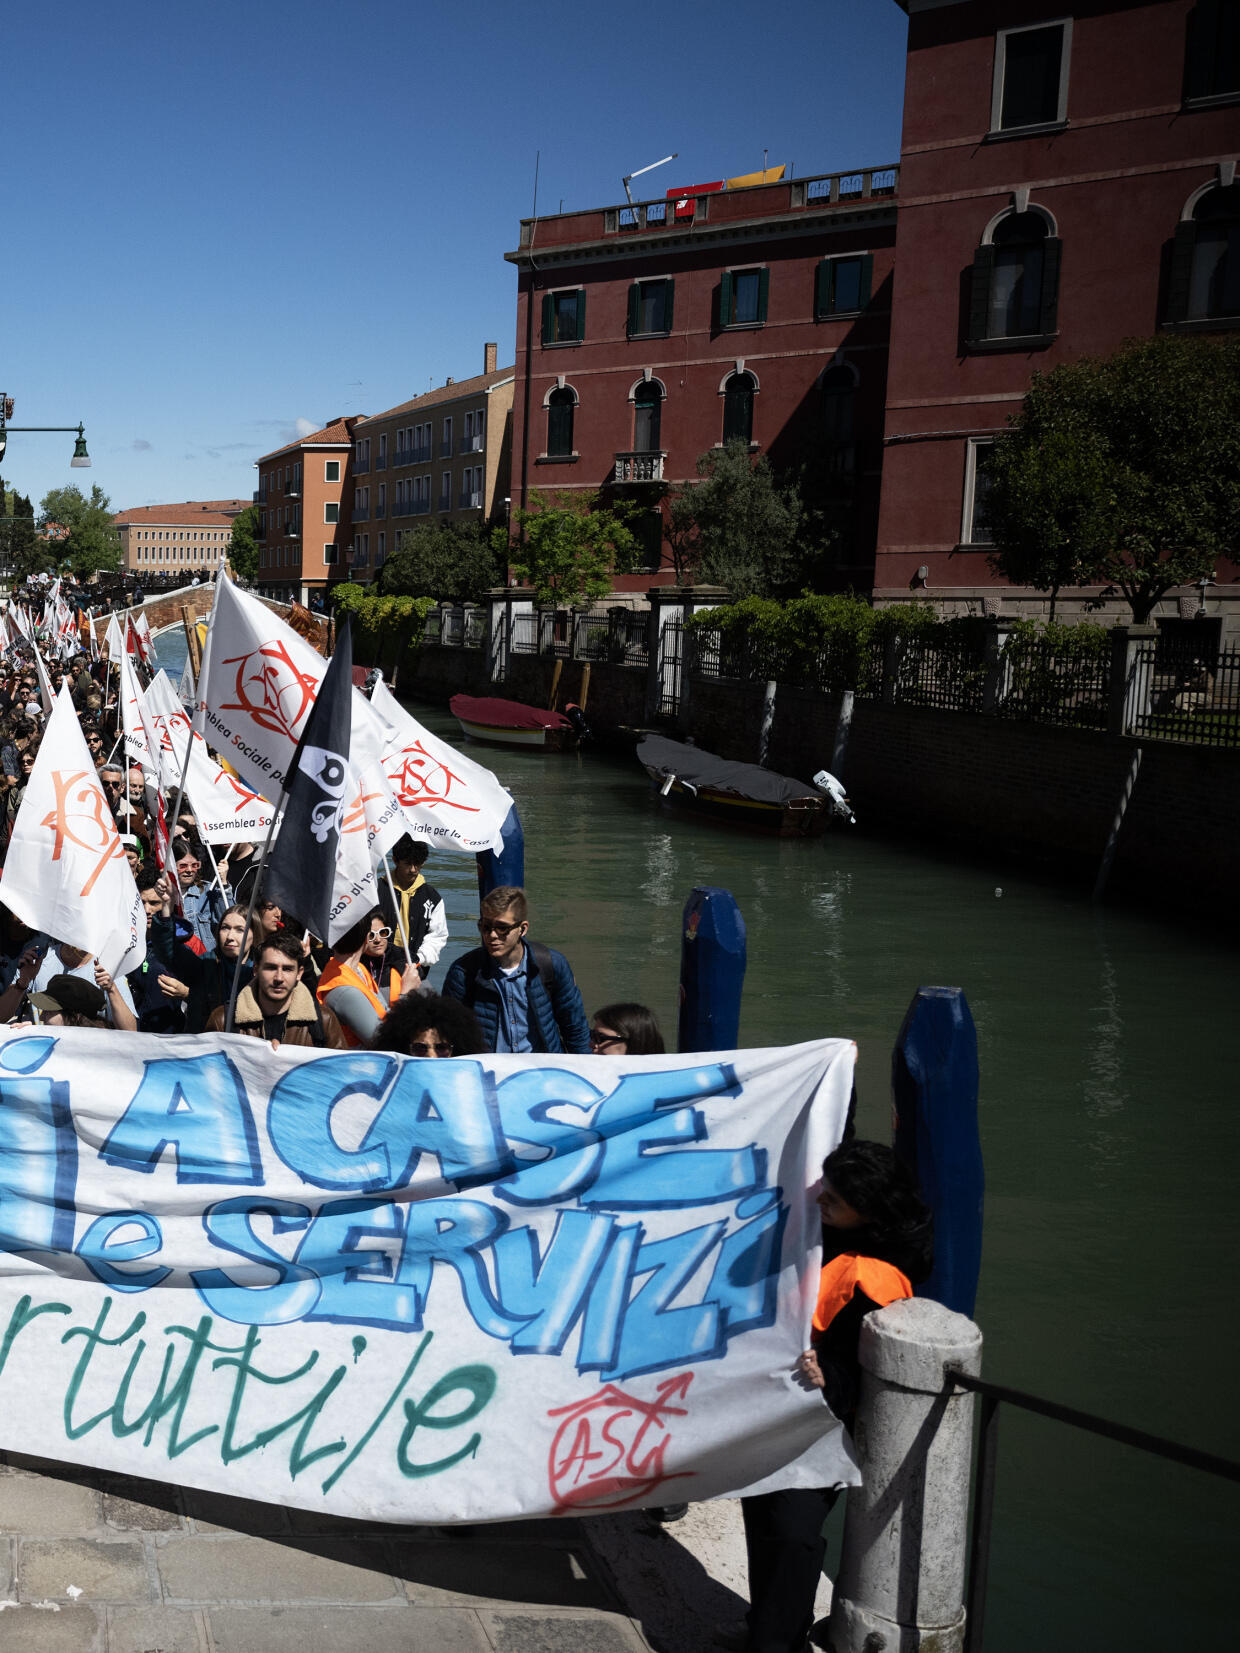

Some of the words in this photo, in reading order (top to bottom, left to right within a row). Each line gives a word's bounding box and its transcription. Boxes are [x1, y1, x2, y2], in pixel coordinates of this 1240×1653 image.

[231, 735, 272, 771] Sociale
[434, 827, 449, 836] per
[450, 830, 461, 838] la
[98, 1052, 264, 1187] A
[266, 1053, 765, 1210] CASE
[72, 1209, 174, 1292] e
